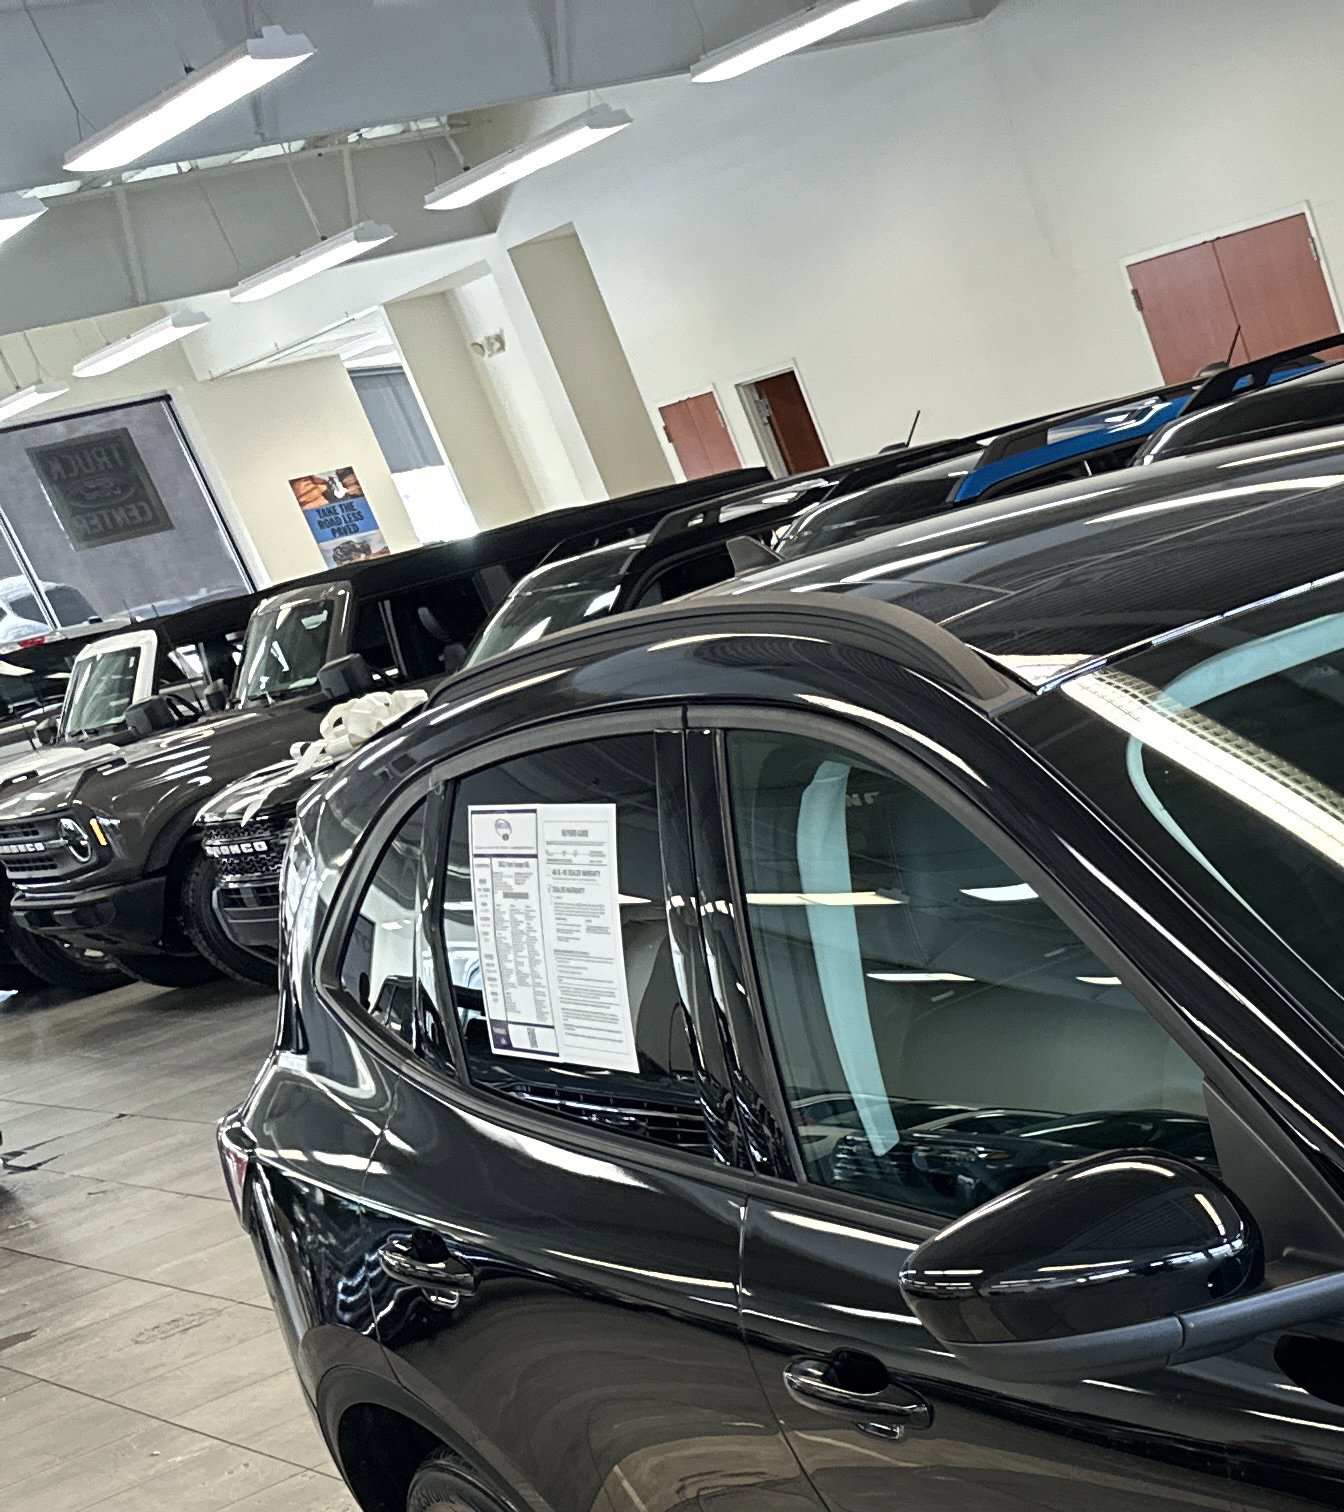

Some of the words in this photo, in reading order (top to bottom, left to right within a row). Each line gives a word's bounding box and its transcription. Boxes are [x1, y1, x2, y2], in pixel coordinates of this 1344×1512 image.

[316, 507, 338, 519] TAKE
[338, 501, 358, 514] THE
[317, 516, 343, 530] ROAD
[343, 510, 364, 524] LESS
[331, 523, 360, 538] PAVED
